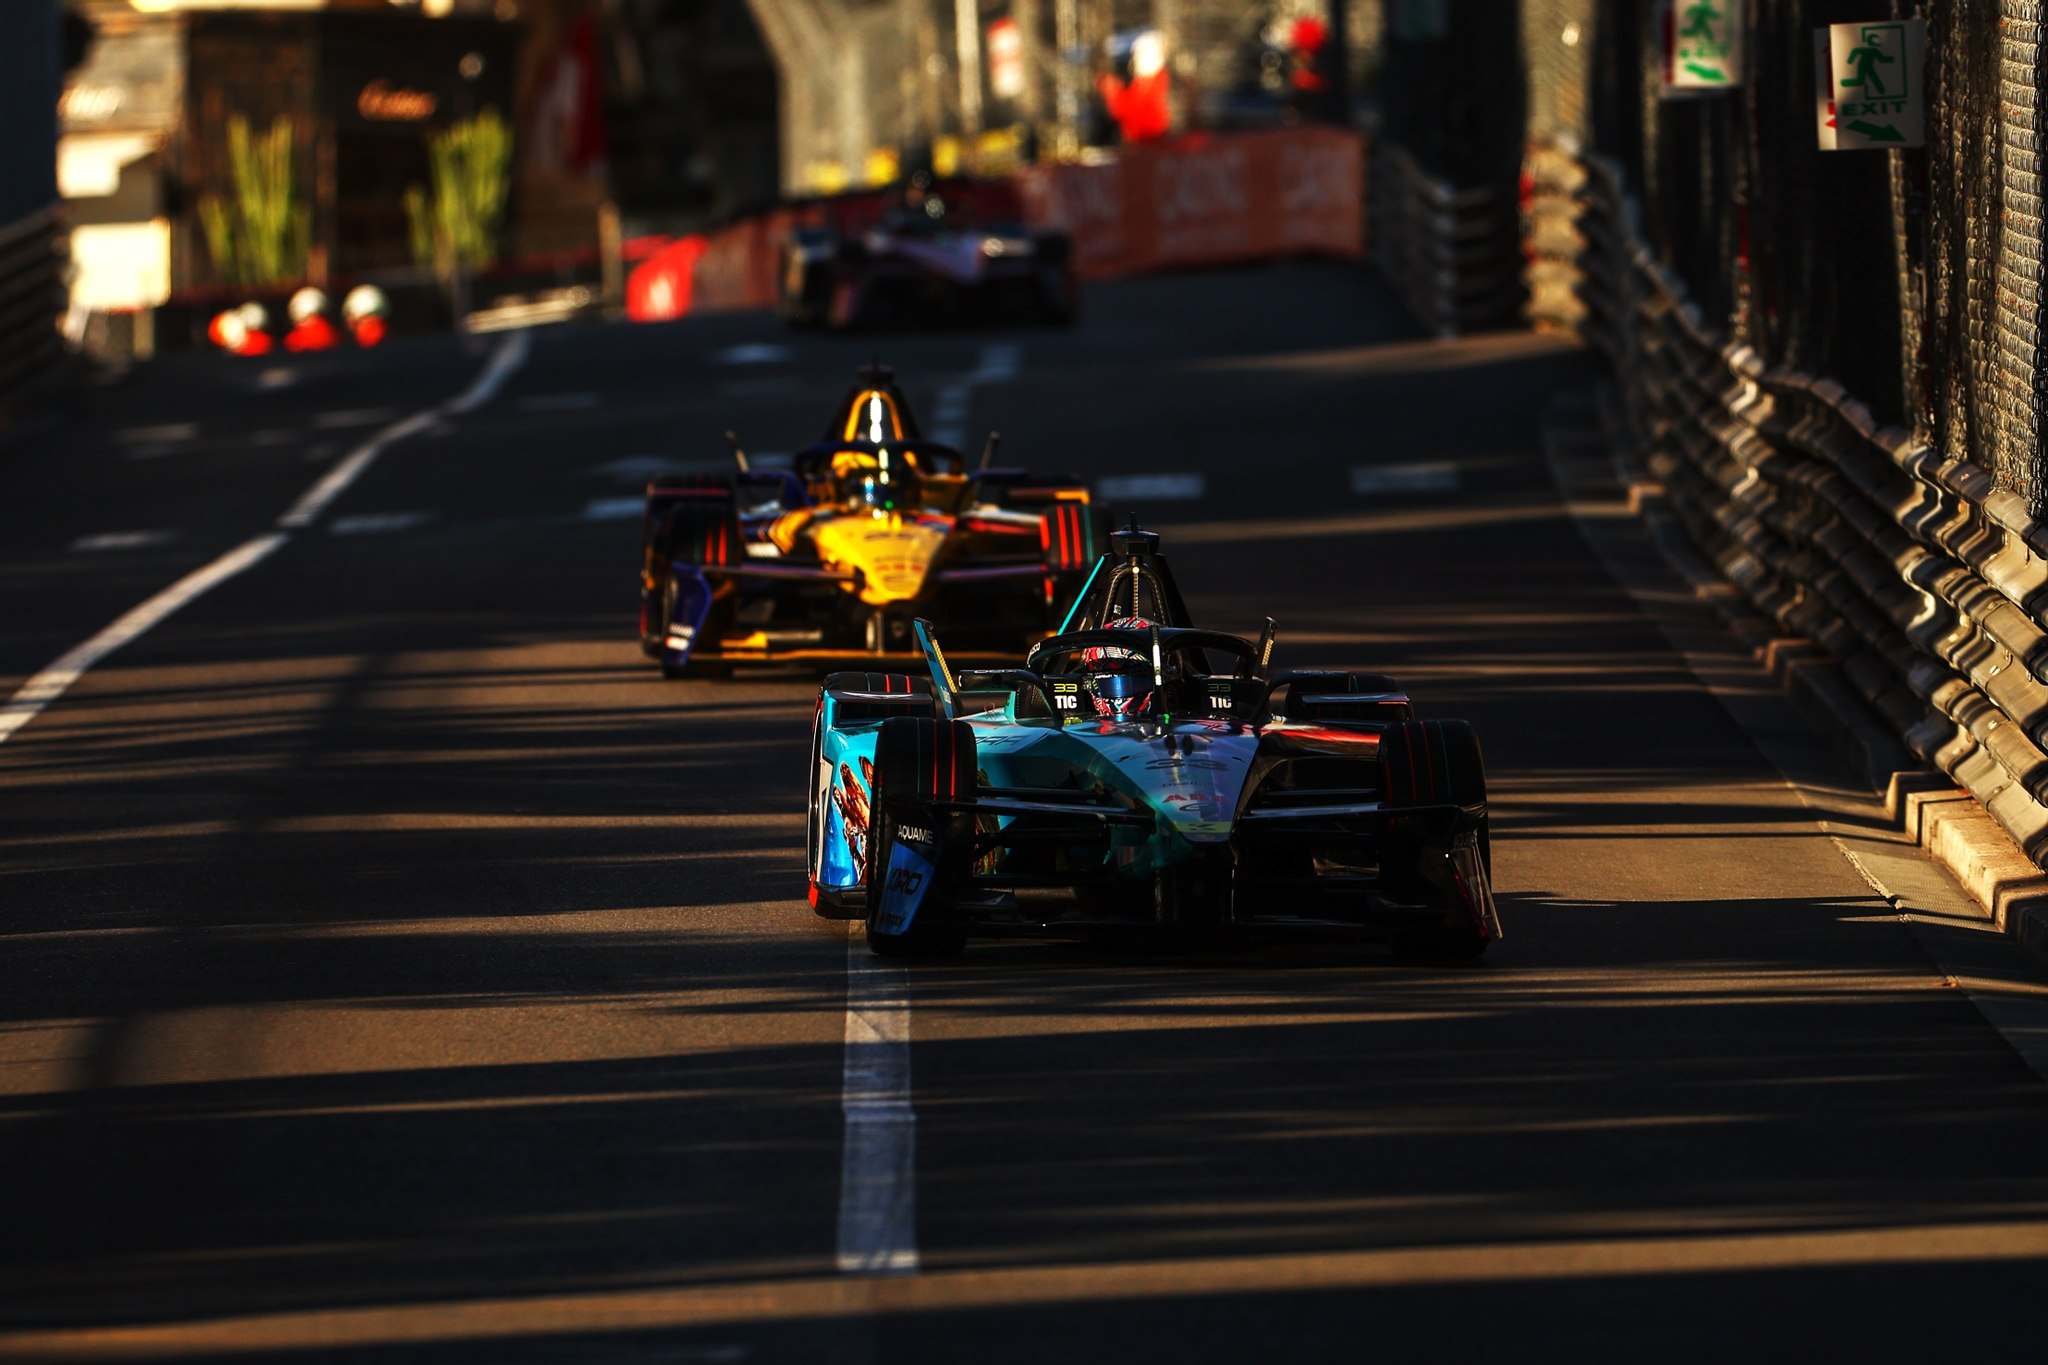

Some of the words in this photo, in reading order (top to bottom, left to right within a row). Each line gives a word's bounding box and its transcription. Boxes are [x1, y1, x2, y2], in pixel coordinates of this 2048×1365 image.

[1843, 101, 1908, 116] EXIT
[1053, 683, 1078, 692] 33
[1207, 683, 1231, 692] 33
[1054, 695, 1078, 709] TIC
[1209, 695, 1232, 709] TIC
